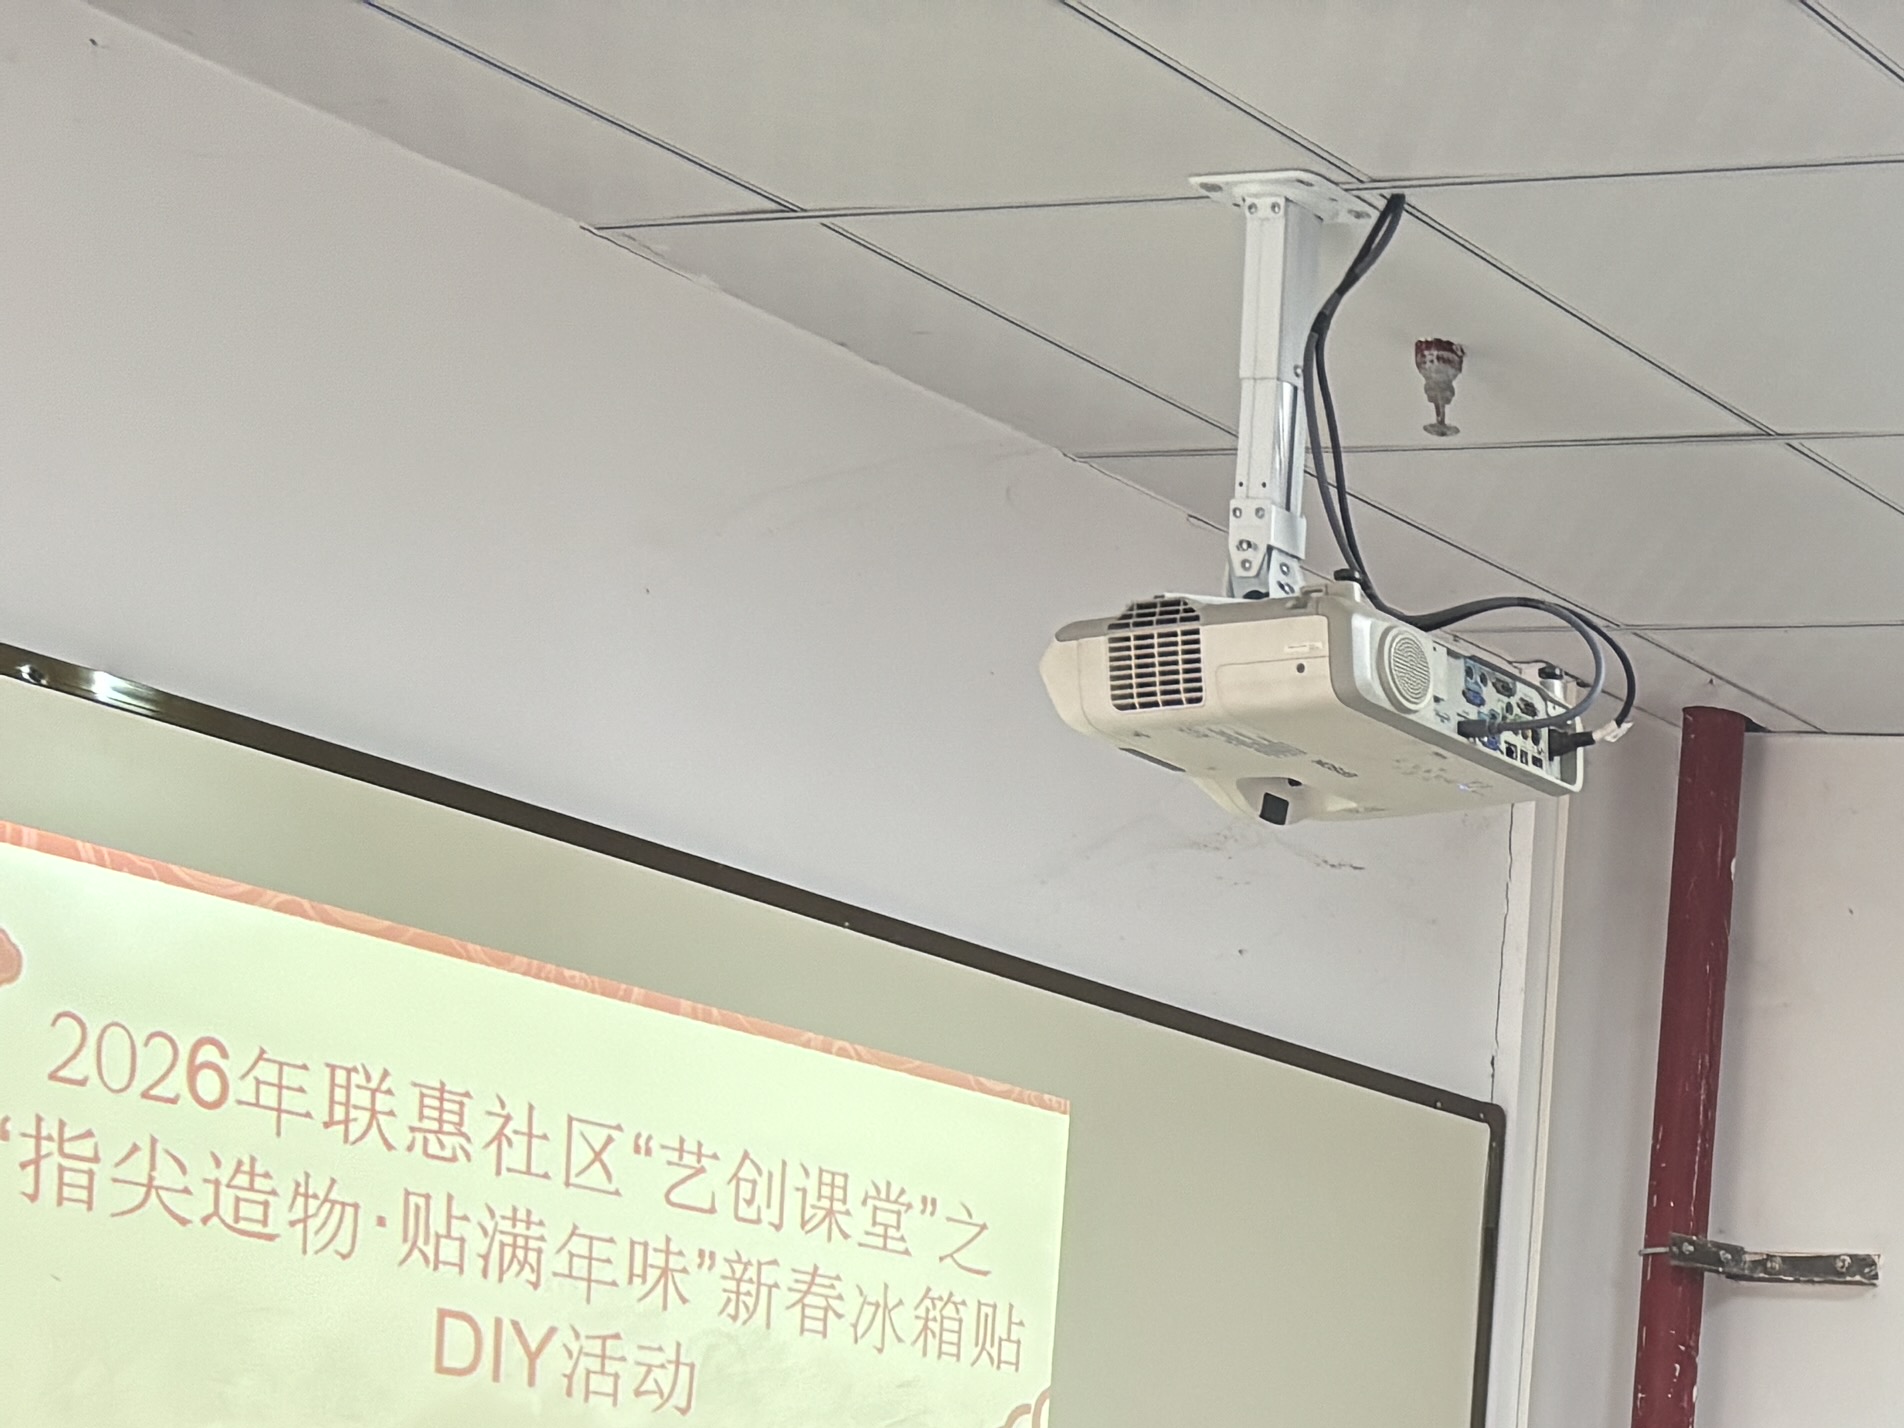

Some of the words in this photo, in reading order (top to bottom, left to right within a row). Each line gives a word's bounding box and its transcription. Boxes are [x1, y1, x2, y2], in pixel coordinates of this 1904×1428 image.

[0, 1113, 1026, 1373] “指尖造物·贴满年味”新春冰箱贴
[46, 1010, 992, 1278] 2026年联惠社区“艺创课堂”之
[434, 1307, 696, 1415] DIY活动
